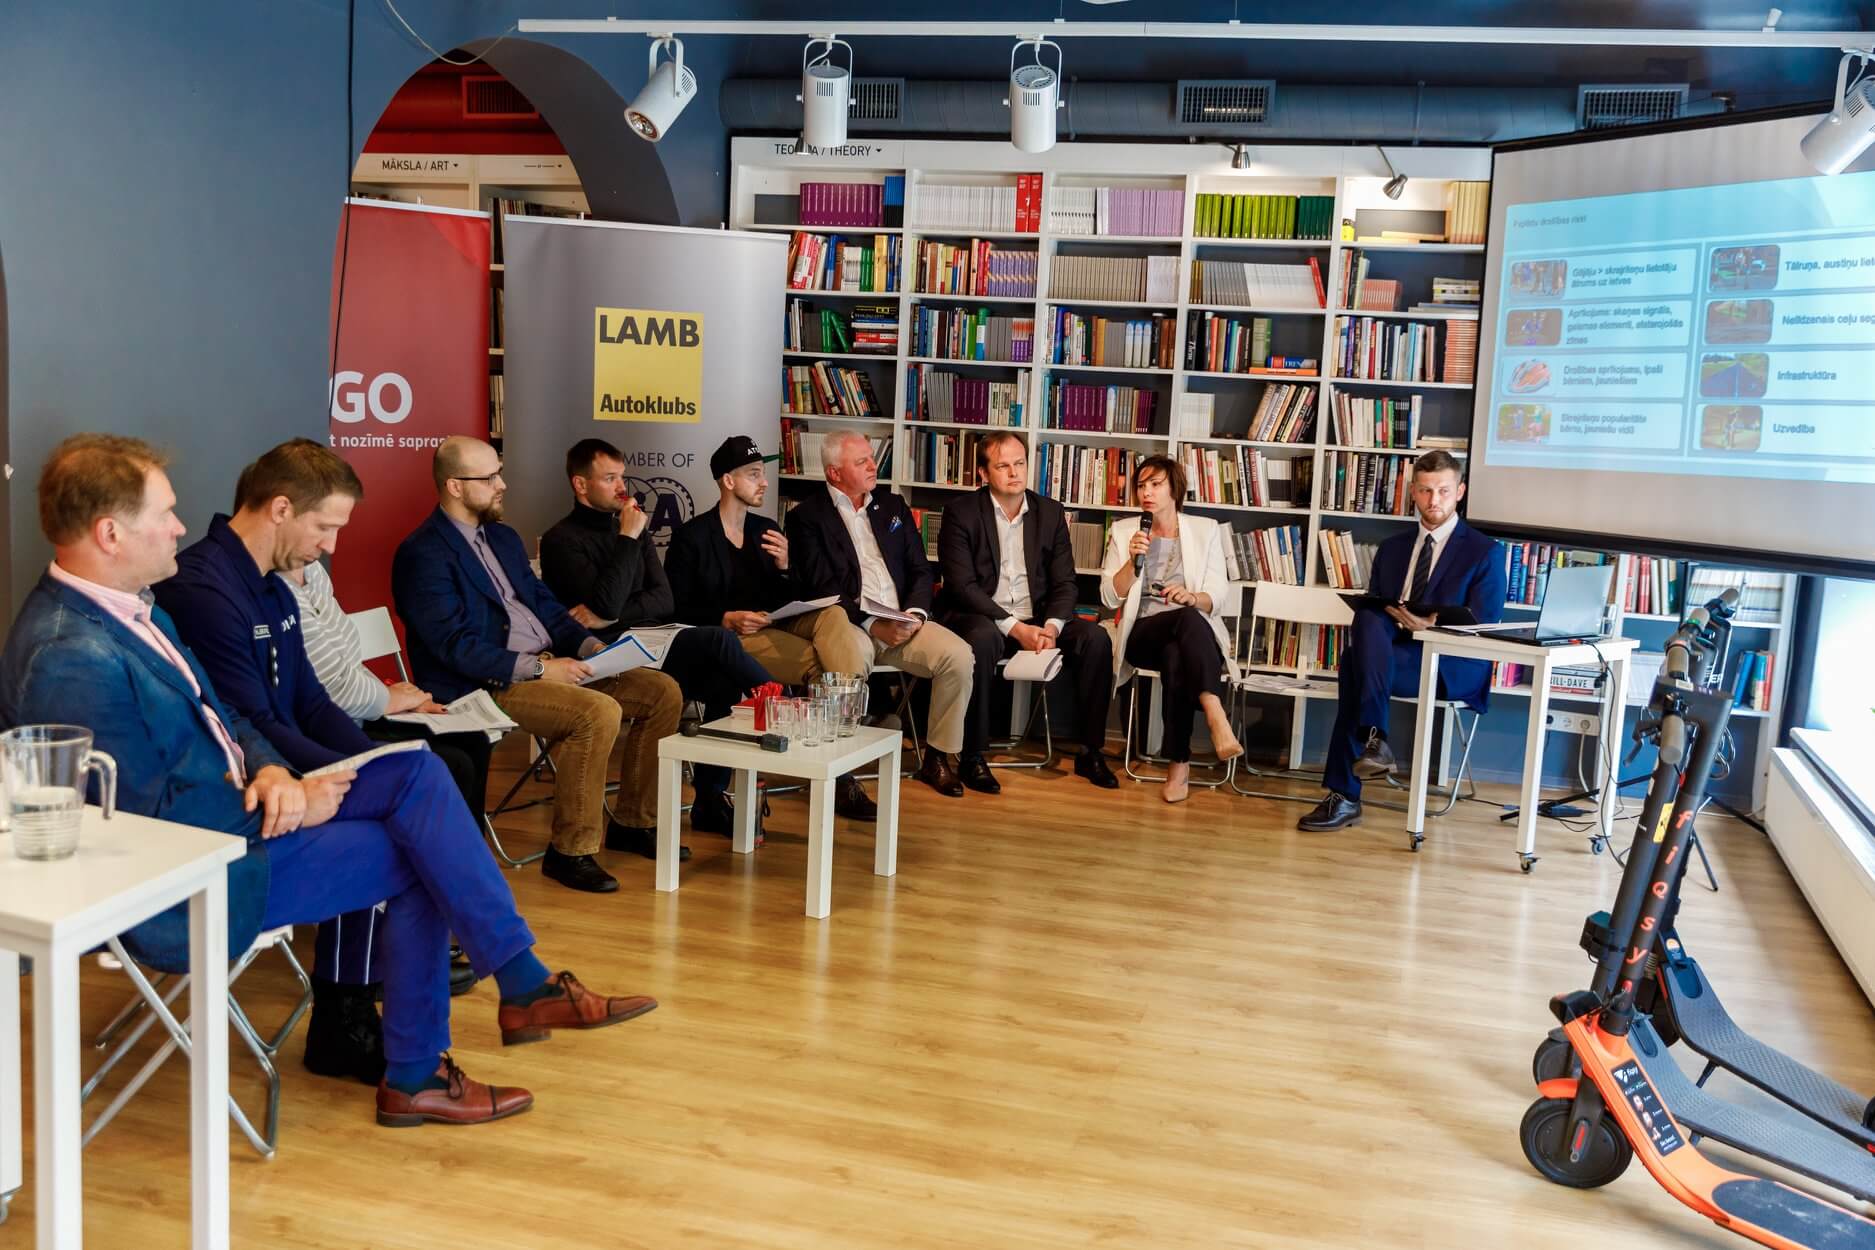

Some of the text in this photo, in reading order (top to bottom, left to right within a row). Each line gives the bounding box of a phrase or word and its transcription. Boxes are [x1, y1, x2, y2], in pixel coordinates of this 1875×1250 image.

[774, 143, 818, 156] TEOA
[382, 157, 422, 171] MĀKSLA
[430, 160, 449, 171] ART
[600, 314, 700, 347] LAMB
[1777, 370, 1837, 381] Infrastruktūra
[329, 370, 413, 424] GO
[600, 393, 697, 416] Autoklubs
[340, 433, 394, 448] nozīmē
[624, 451, 696, 468] MBER OF
